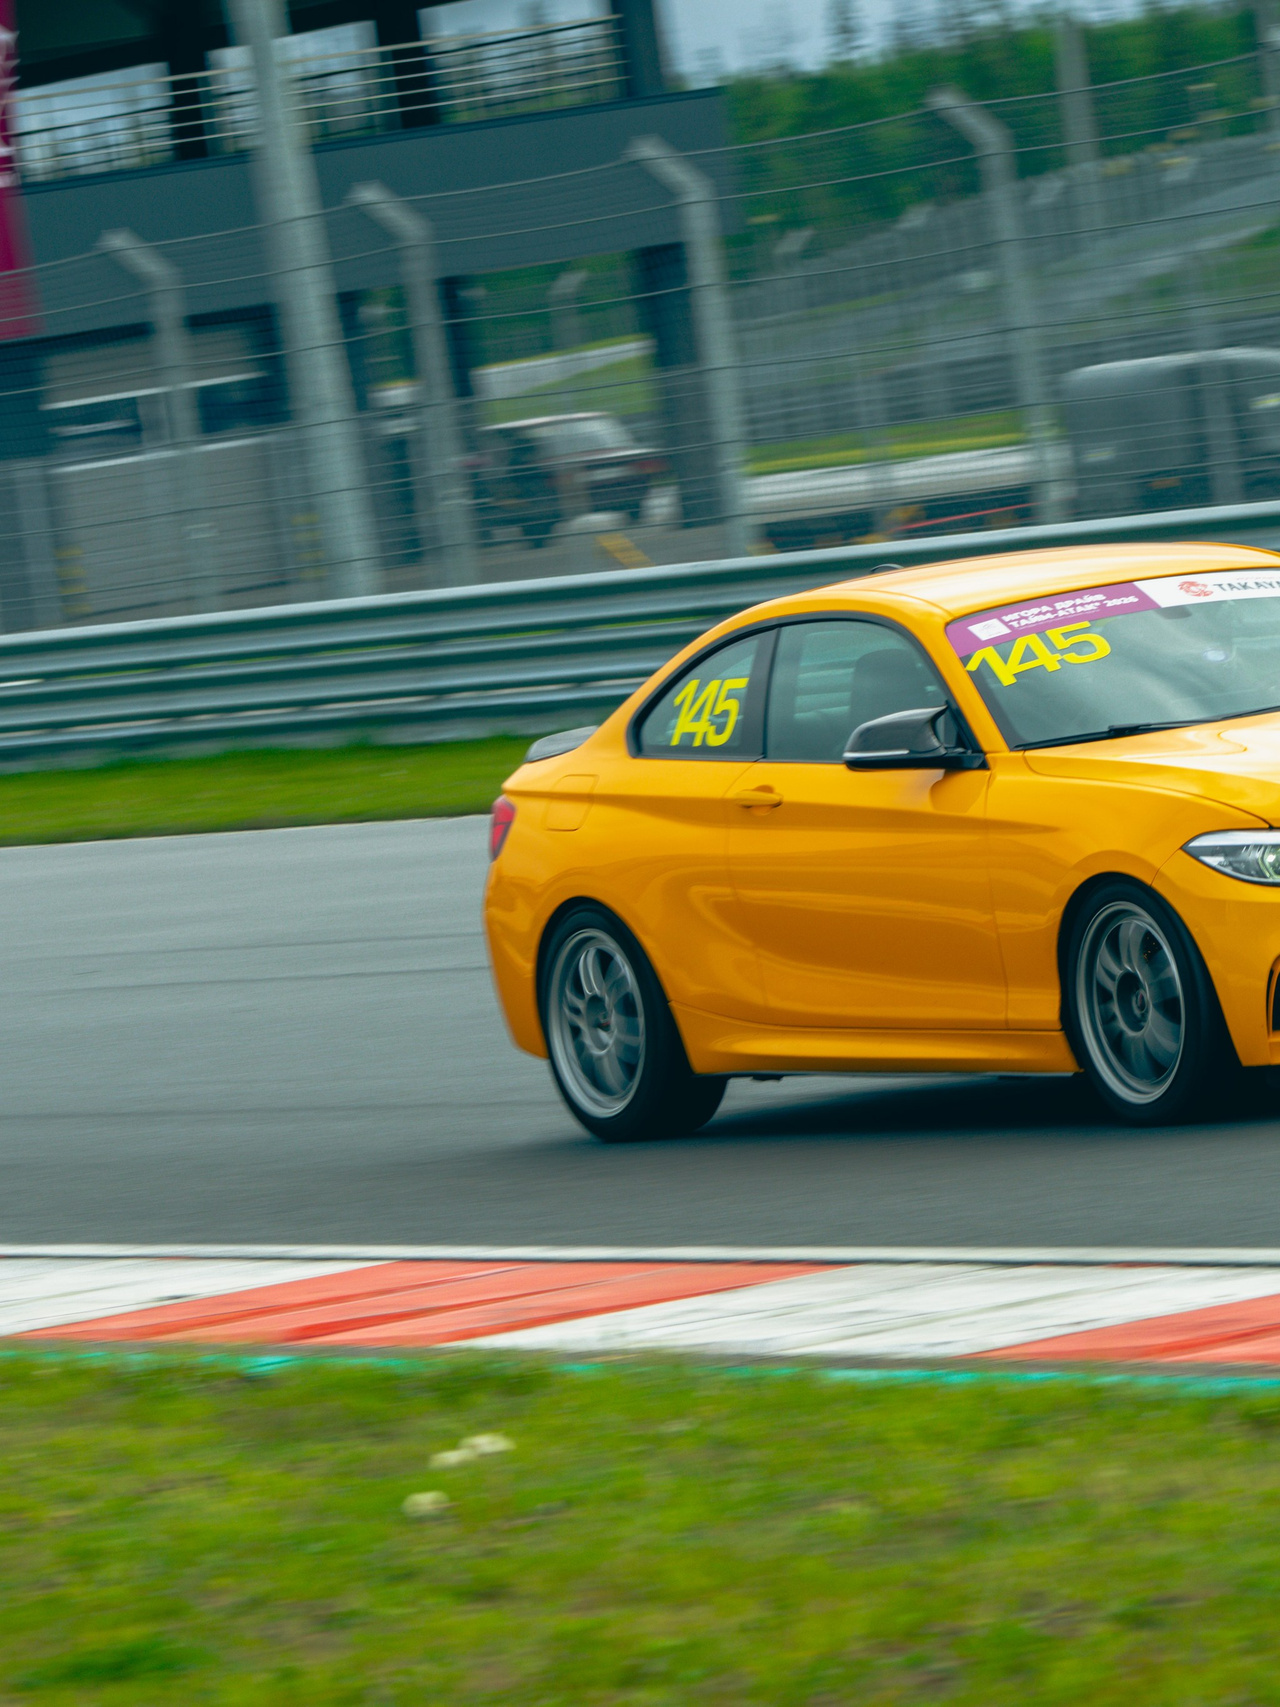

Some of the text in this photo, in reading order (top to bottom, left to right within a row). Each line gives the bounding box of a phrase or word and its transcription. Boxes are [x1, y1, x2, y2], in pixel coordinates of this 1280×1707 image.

[1001, 605, 1053, 622] ИГОРА
[1053, 594, 1106, 610] ДРАЙВ
[965, 620, 1111, 687] 145
[670, 677, 749, 747] 145
